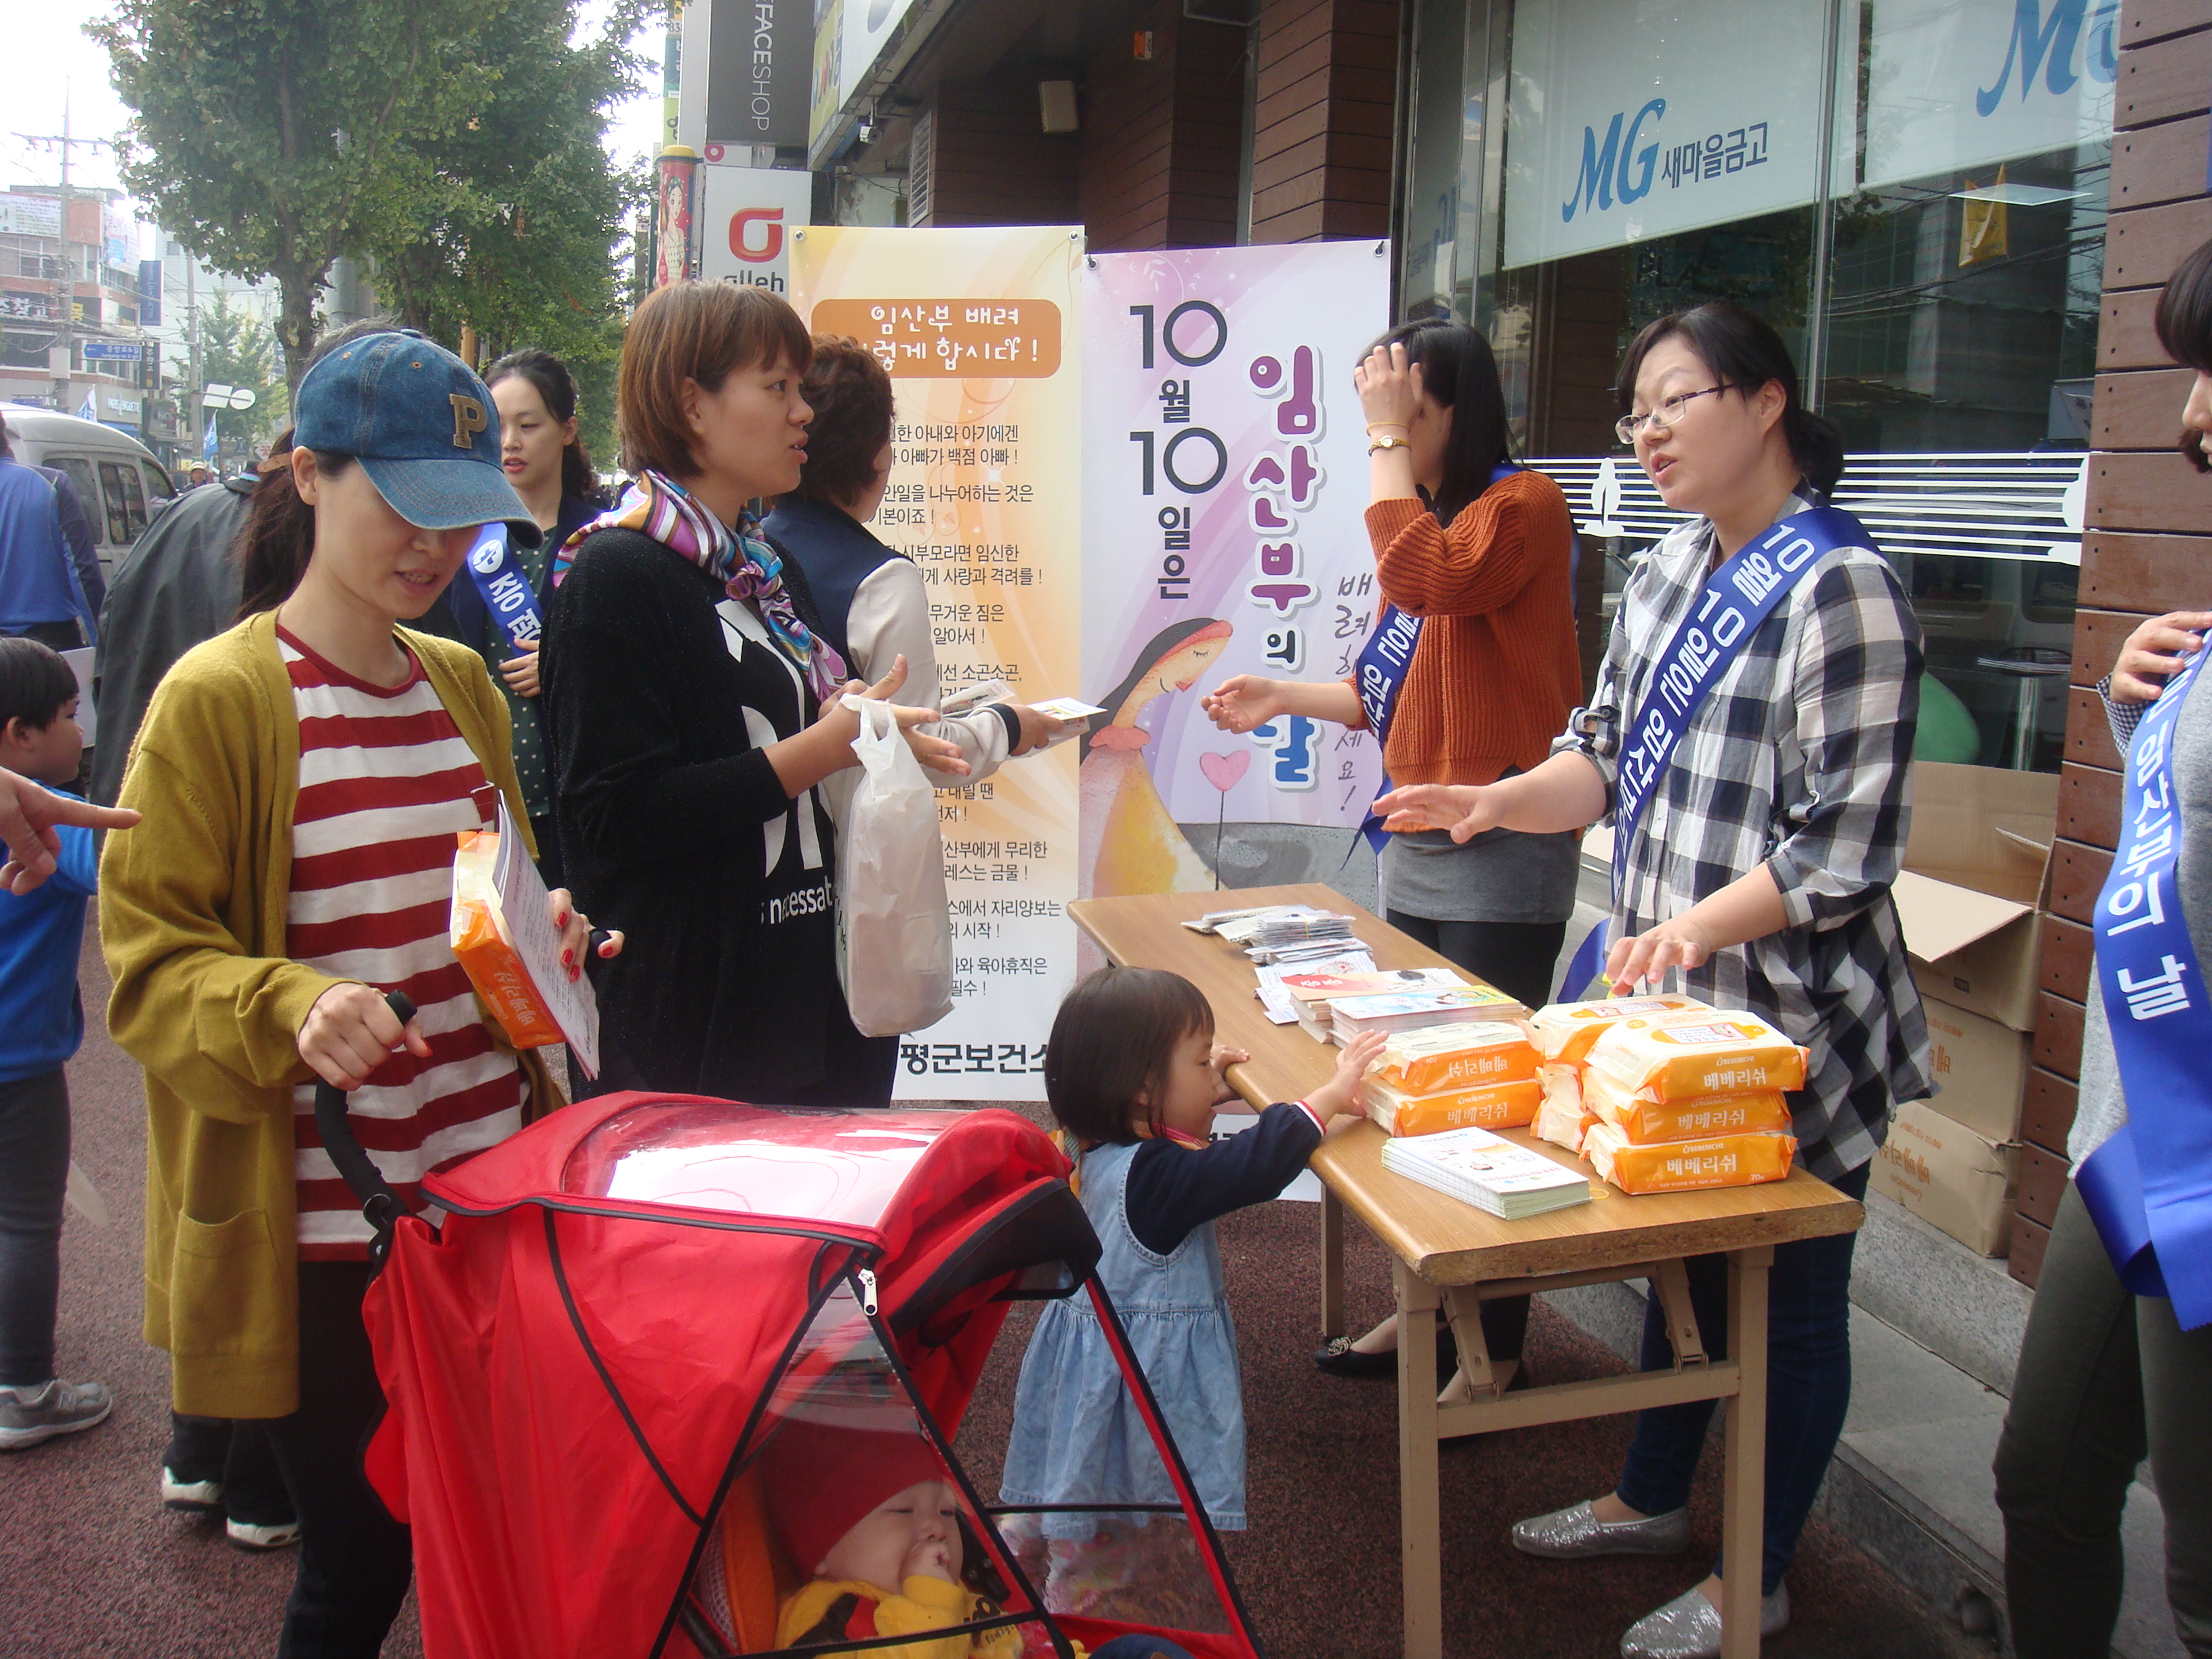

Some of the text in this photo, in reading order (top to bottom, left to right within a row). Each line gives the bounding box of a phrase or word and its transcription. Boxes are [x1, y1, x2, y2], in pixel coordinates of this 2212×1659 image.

[1562, 98, 1767, 223] MG 새마을금고
[870, 305, 1019, 335] 임산부 배려
[863, 339, 926, 371] 렇게
[936, 337, 1021, 371] 합시다
[449, 393, 487, 449] P
[915, 425, 958, 443] 아내와
[962, 425, 1019, 443] 아기에겐
[901, 447, 944, 466] 아빠가
[948, 447, 975, 466] 백점
[980, 448, 1009, 466] 아빠
[929, 485, 1001, 502] 나누어하는
[1005, 485, 1033, 502] 것은
[977, 544, 1019, 562] 임신한
[1732, 524, 1816, 607] 10월
[943, 568, 987, 586] 사랑과
[991, 568, 1033, 586] 격려를
[929, 605, 1004, 622] 무거운 짐은
[933, 628, 975, 644] 알아서
[1658, 588, 1746, 717] 10일은
[980, 783, 994, 800] 땐
[2106, 719, 2173, 937] 임산부의
[941, 841, 1047, 858] 산부에게 무리한
[945, 864, 987, 881] 레스는
[991, 864, 1019, 881] 금물
[991, 899, 1061, 917] 자리양보는
[963, 922, 991, 939] 시작
[977, 957, 1047, 975] 육아휴직은
[2116, 954, 2190, 1021] 날
[1703, 1067, 1767, 1091] 베베리쉬
[1447, 1102, 1508, 1125] 베베리쉬
[1677, 1108, 1746, 1130] 베베리쉬
[1666, 1153, 1738, 1176] 베베리쉬
